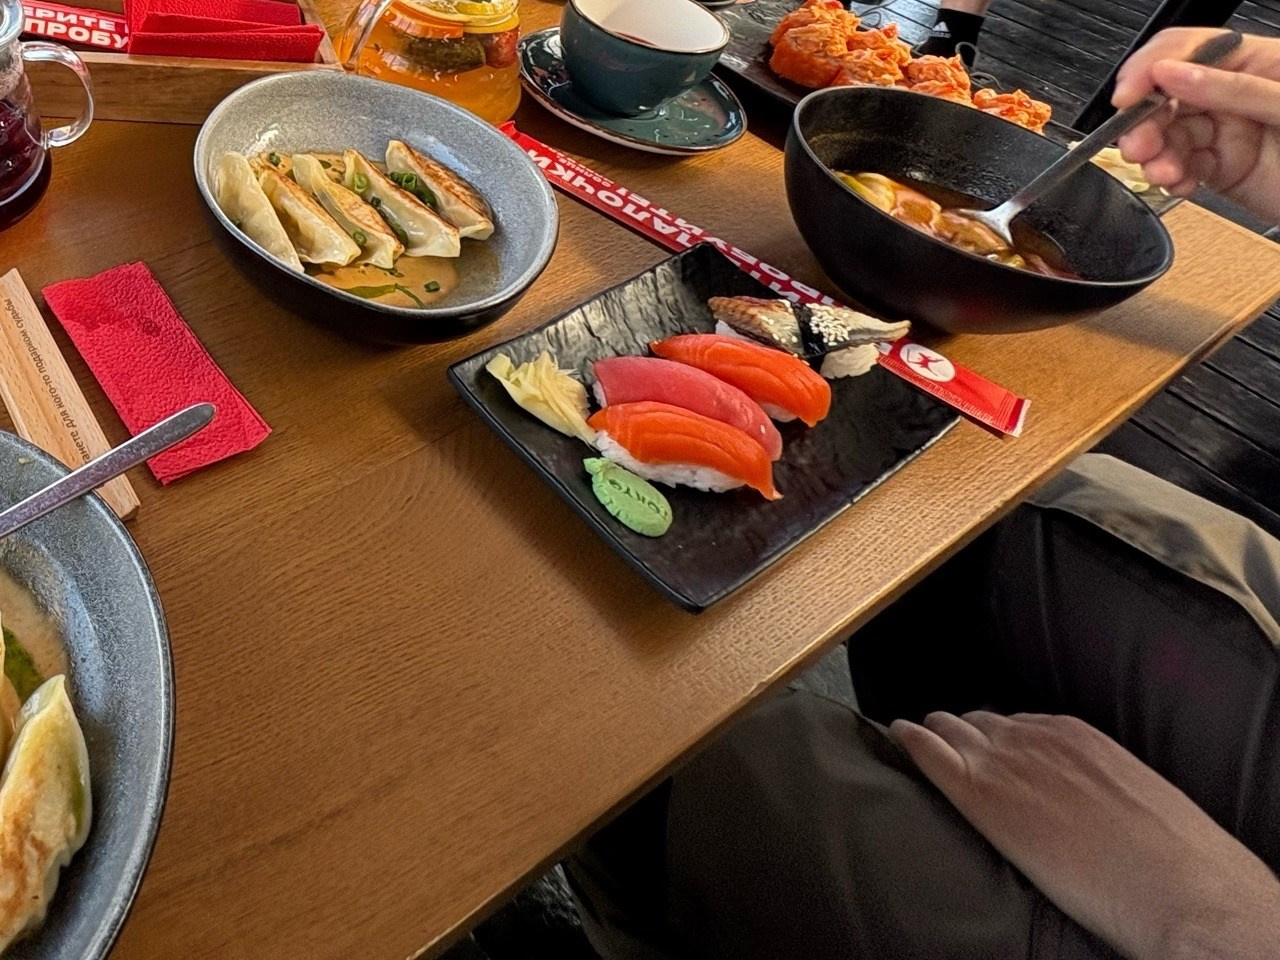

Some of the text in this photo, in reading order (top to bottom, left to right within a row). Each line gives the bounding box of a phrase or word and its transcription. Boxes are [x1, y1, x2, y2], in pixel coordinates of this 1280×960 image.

[22, 6, 116, 32] ЕРИТЕ
[24, 17, 130, 49] ПРОБУ
[4, 298, 25, 329] судьбы
[20, 329, 47, 374] подарком
[42, 374, 66, 409] кого-то
[60, 409, 78, 429] для
